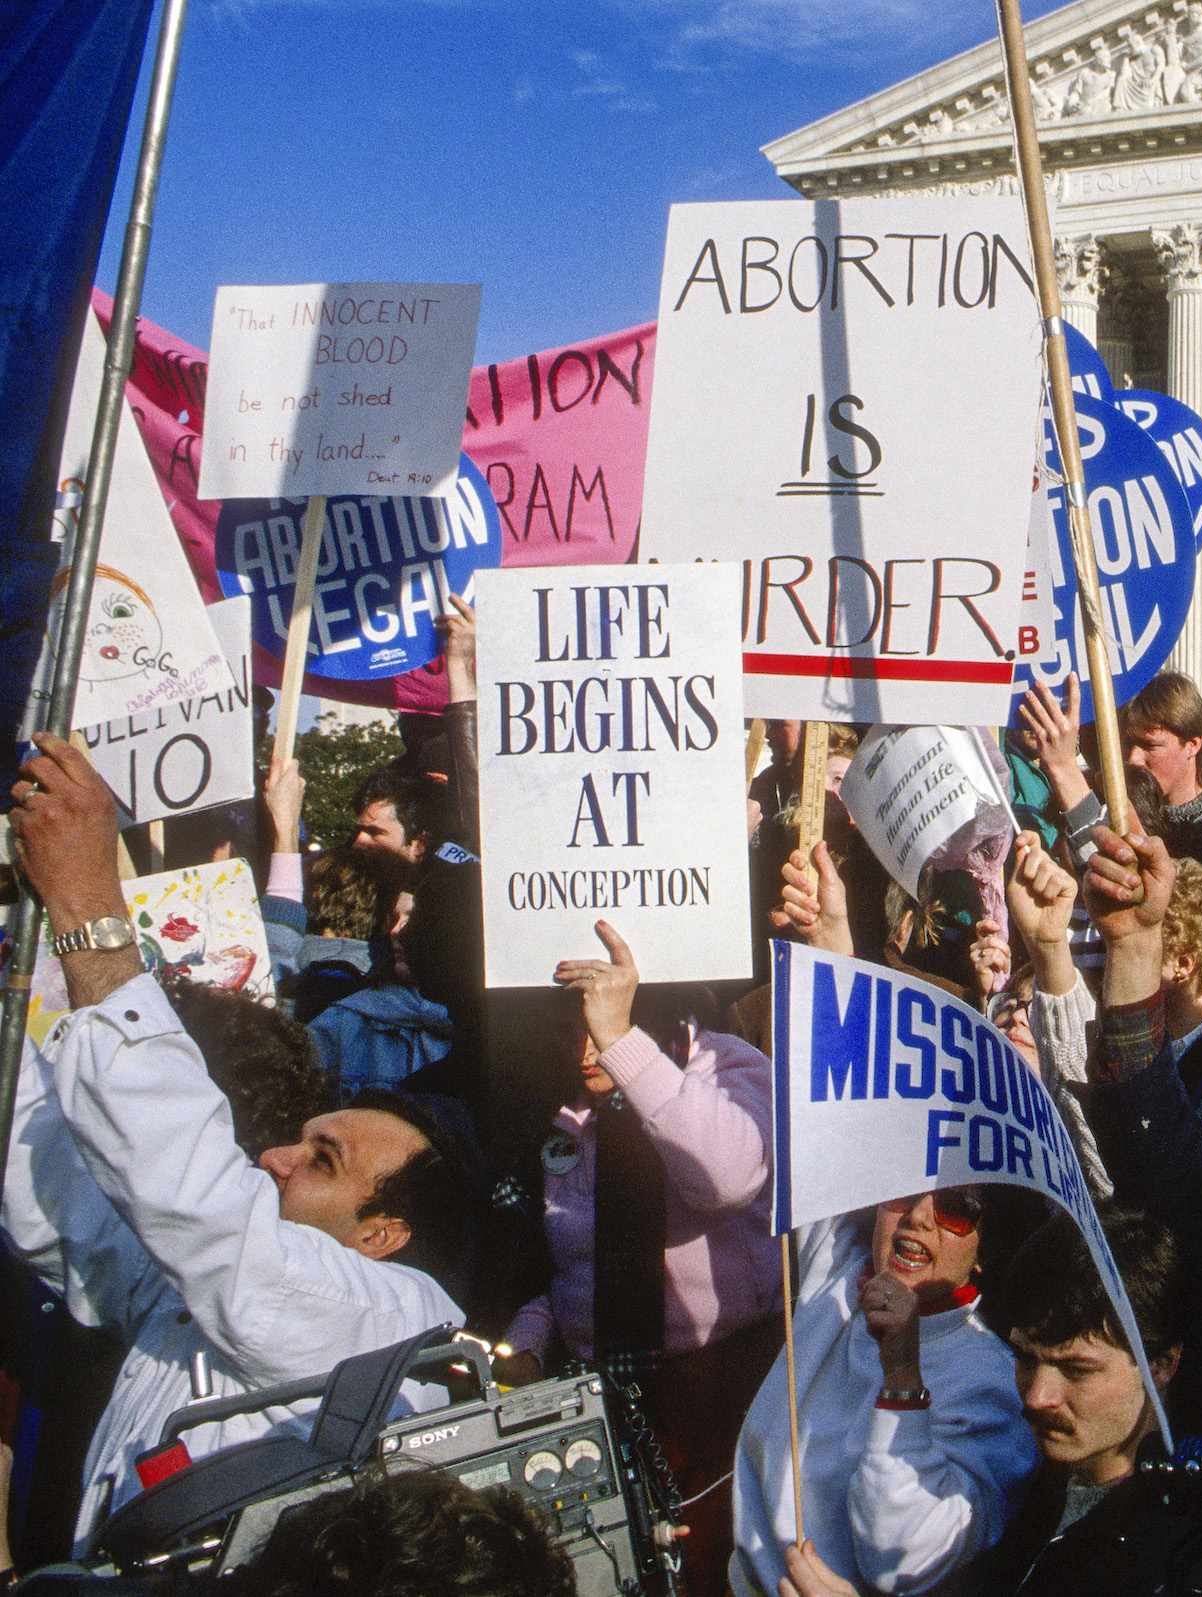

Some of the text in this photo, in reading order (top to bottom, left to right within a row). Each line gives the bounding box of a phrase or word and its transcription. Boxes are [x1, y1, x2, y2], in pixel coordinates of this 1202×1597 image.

[1080, 169, 1166, 195] EQUAL
[673, 231, 1036, 314] ABORTION
[292, 299, 440, 326] INNOCENT
[316, 335, 408, 365] BLOOD
[238, 387, 392, 413] be not shed
[466, 339, 645, 430] TION
[229, 437, 247, 462] in
[269, 438, 301, 475] thy
[801, 393, 882, 480] IS
[533, 584, 671, 662] LIFE
[649, 555, 1016, 661] RDER.
[495, 675, 718, 756] BEGINS
[924, 762, 955, 793] Life
[567, 771, 650, 848] AT
[508, 867, 710, 911] CONCEPTION
[925, 1109, 1034, 1179] FOR
[408, 1426, 460, 1449] SONY
